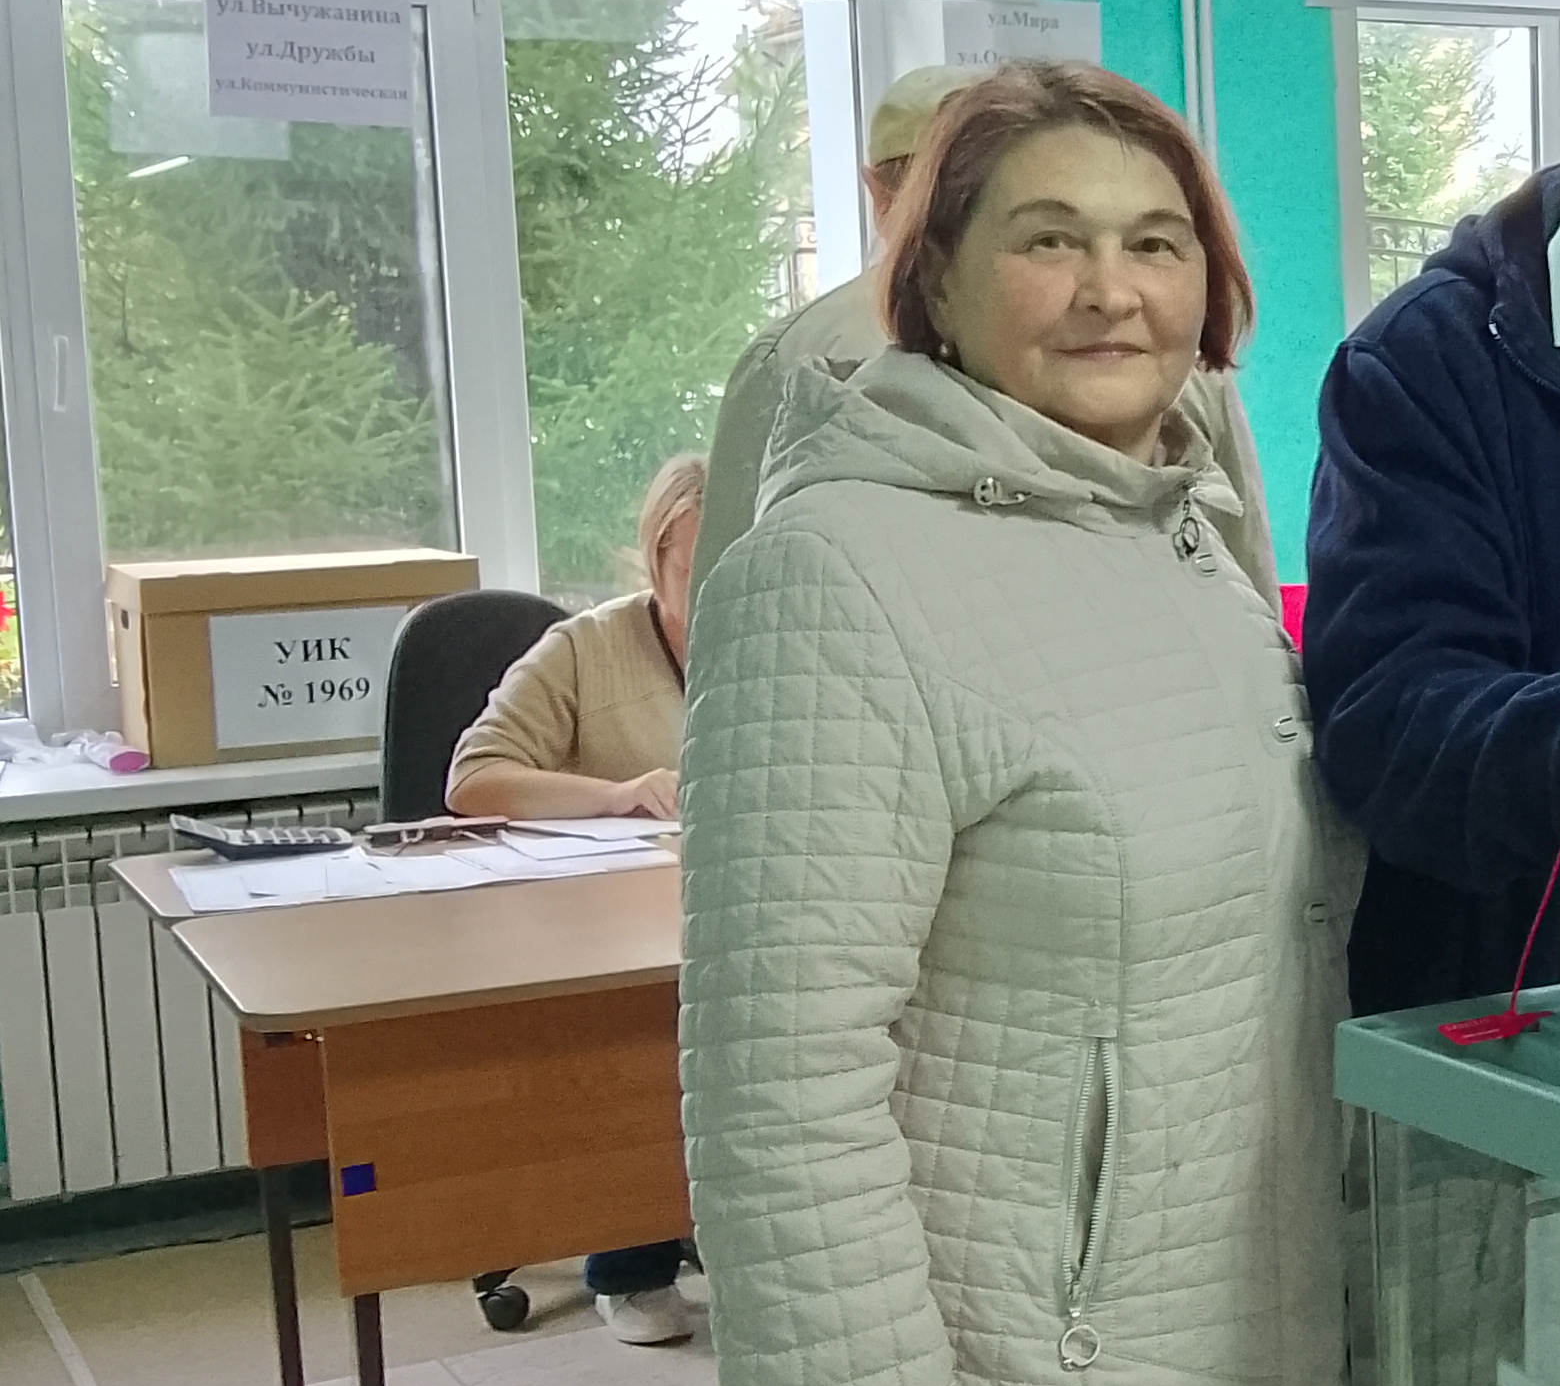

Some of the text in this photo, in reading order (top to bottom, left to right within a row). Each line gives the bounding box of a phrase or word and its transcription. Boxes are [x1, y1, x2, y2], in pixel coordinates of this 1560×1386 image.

[987, 11, 1059, 32] ул.Мира
[246, 40, 375, 63] ул.Дружбы
[215, 77, 408, 100] ул.Коммунистическая
[273, 635, 352, 665] УИК
[257, 676, 371, 707] № 1969
